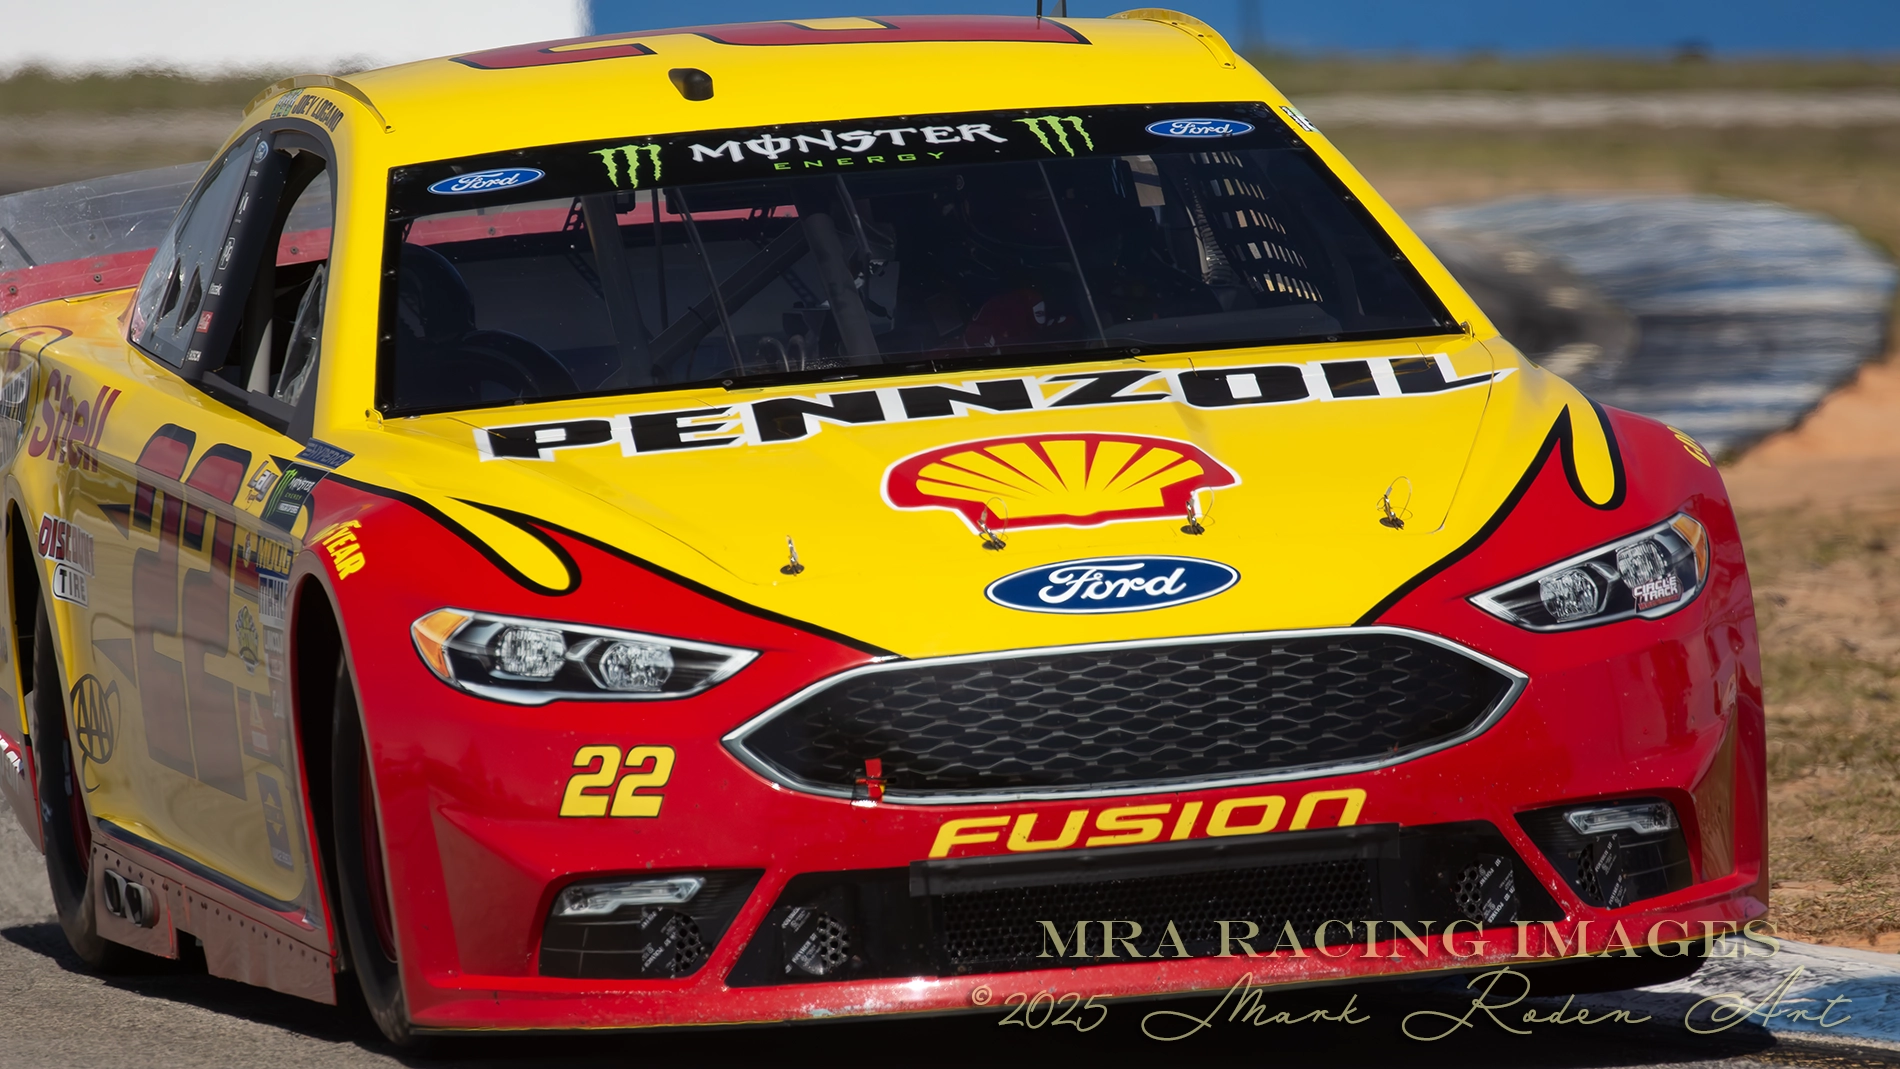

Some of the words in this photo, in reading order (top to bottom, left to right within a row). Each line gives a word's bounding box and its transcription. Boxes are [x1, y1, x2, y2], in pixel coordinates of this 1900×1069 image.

[311, 97, 345, 133] LOGANO
[1169, 121, 1234, 135] Ford
[688, 123, 1008, 163] MONSTER
[773, 151, 945, 171] ENERGY
[450, 172, 521, 192] Ford
[27, 368, 122, 474] Shell
[471, 352, 1521, 463] PENNZOIL
[59, 567, 87, 602] TIRE
[1037, 561, 1188, 604] Ford
[1633, 575, 1678, 597] CIRCLE
[1641, 584, 1679, 603] TRACK
[558, 744, 677, 819] 22
[928, 787, 1368, 859] FUSION
